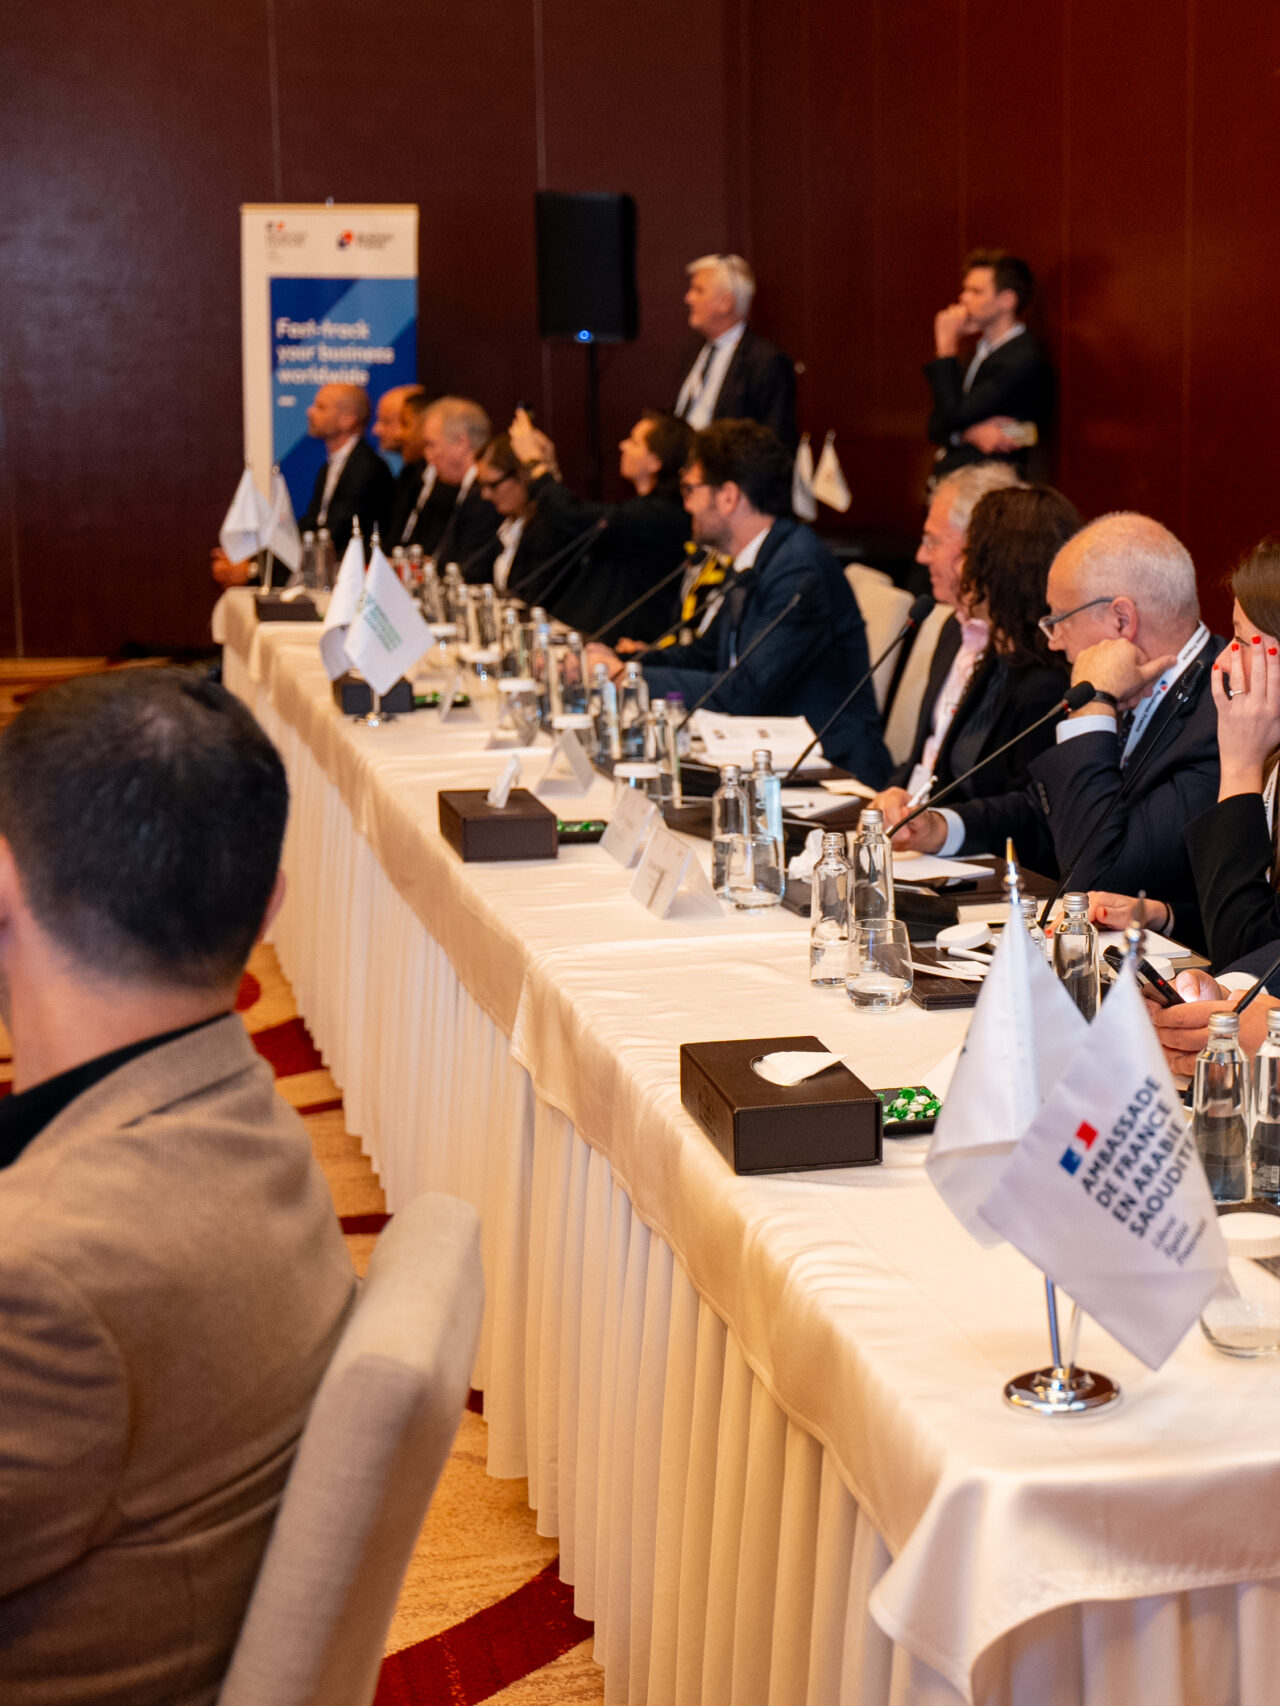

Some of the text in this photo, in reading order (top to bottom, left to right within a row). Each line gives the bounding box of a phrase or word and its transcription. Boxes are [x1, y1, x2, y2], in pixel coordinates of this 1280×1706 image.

[276, 317, 370, 339] Fast-track
[276, 340, 395, 365] your business
[276, 364, 370, 386] worldwide
[1081, 1076, 1161, 1194] AMBASSADE
[1095, 1099, 1171, 1209] DE FRANCE
[1112, 1119, 1183, 1224] EN ARABIE
